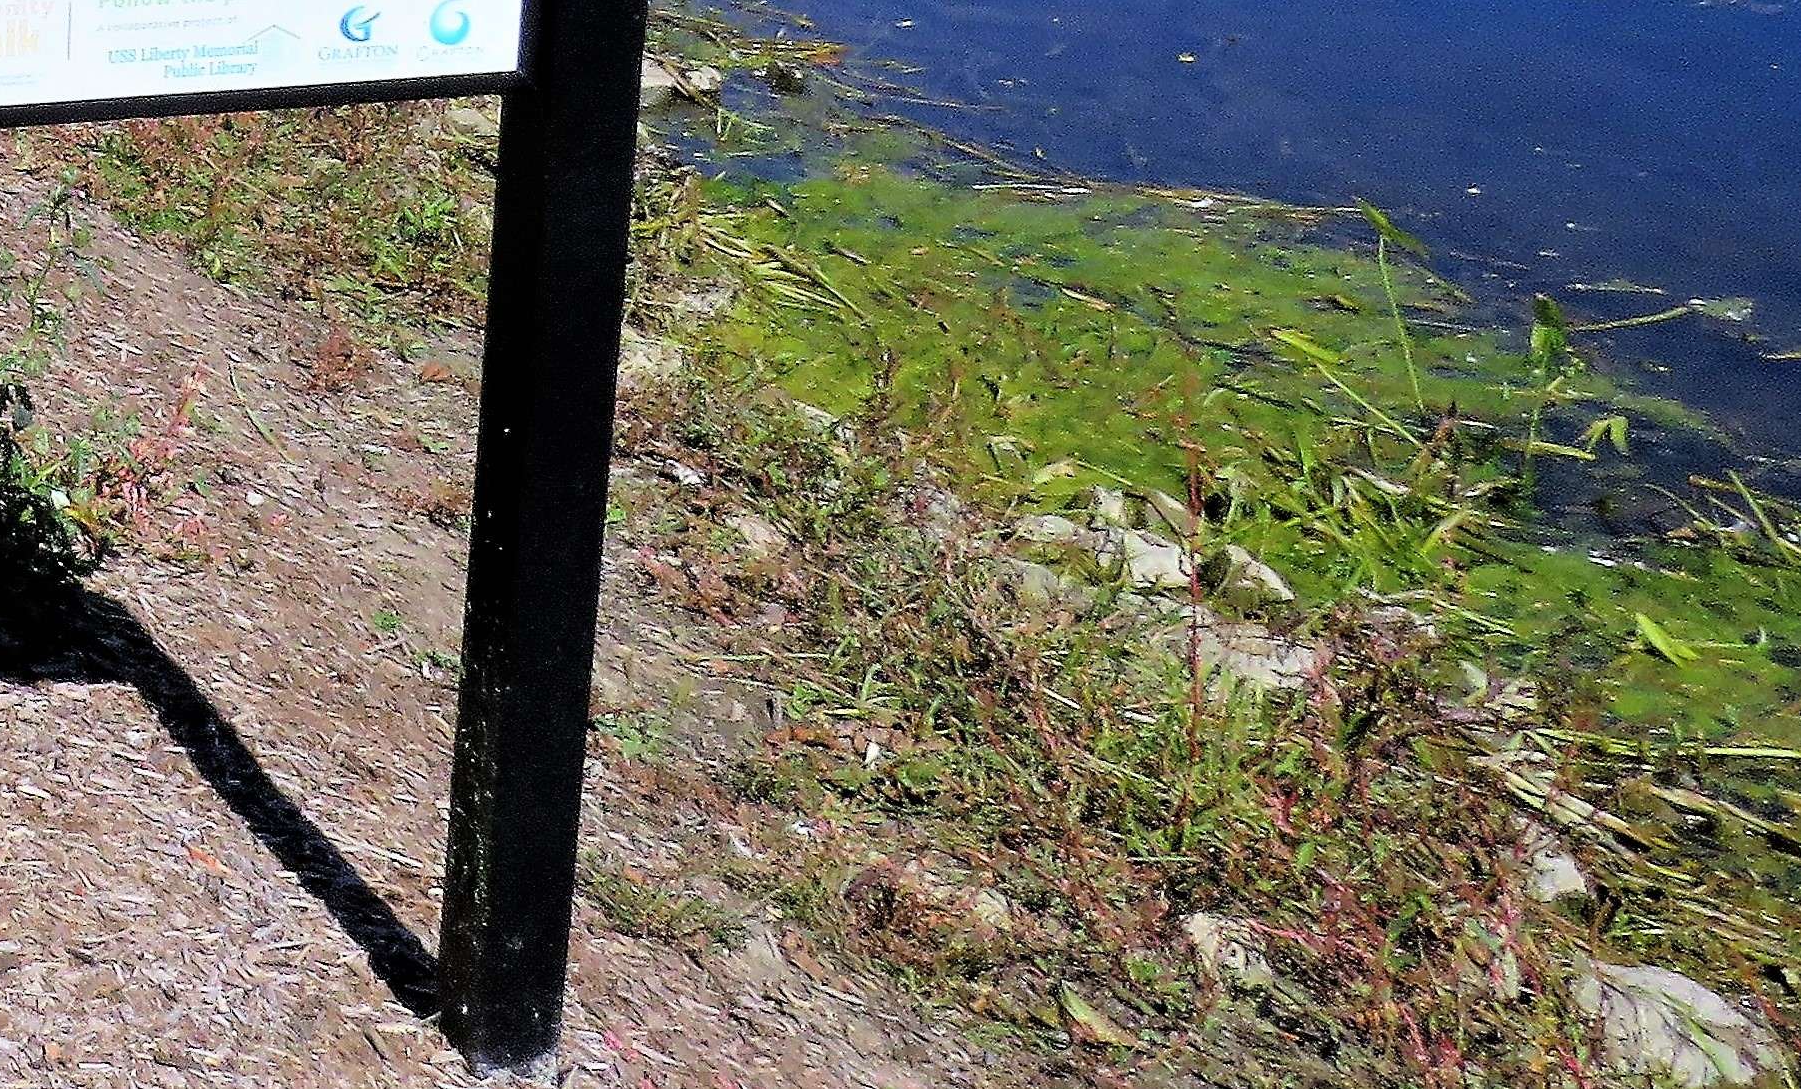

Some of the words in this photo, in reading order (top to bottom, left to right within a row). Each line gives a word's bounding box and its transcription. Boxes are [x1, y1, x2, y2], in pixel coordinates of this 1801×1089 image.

[108, 47, 137, 63] USS
[141, 45, 190, 62] Liberty
[193, 39, 259, 60] Memorial
[163, 59, 206, 78] Public
[209, 60, 257, 76] Library
